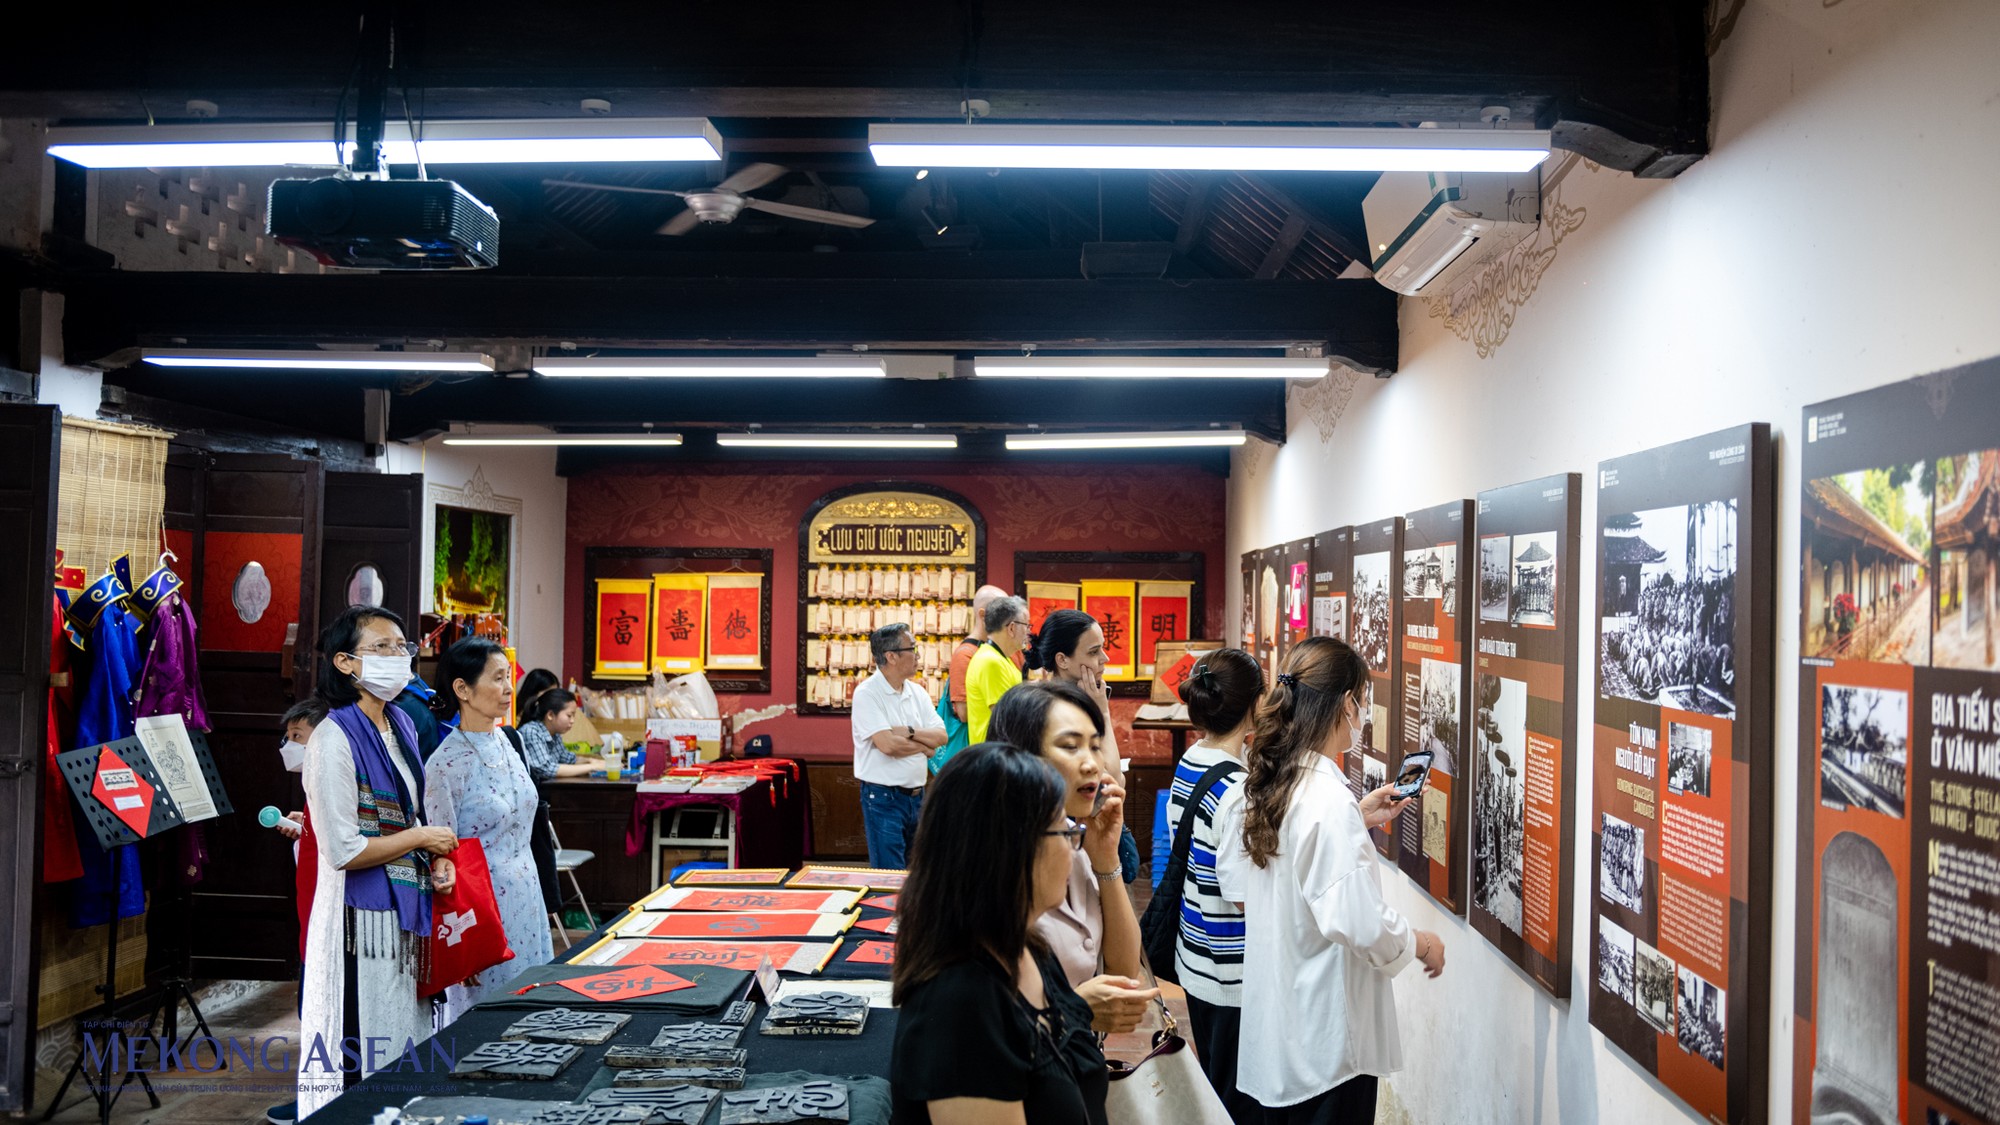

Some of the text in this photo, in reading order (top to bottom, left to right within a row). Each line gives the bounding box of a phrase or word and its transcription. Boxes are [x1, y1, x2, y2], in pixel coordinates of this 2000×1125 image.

[830, 528, 852, 551] LƯU
[879, 524, 902, 551] ƯỚC
[1151, 613, 1177, 643] 明
[1931, 693, 1955, 728] BIA
[1957, 688, 1990, 732] TIẾN
[1629, 721, 1656, 750] TÔN VINH
[1615, 746, 1633, 771] NGƯỜI
[1930, 727, 1944, 769] Ở
[1945, 732, 1975, 776] VĂN
[1930, 778, 1945, 803] THE
[1945, 781, 1973, 810] STONE
[1929, 803, 1946, 827] VAN
[1946, 807, 1968, 833] MIEU
